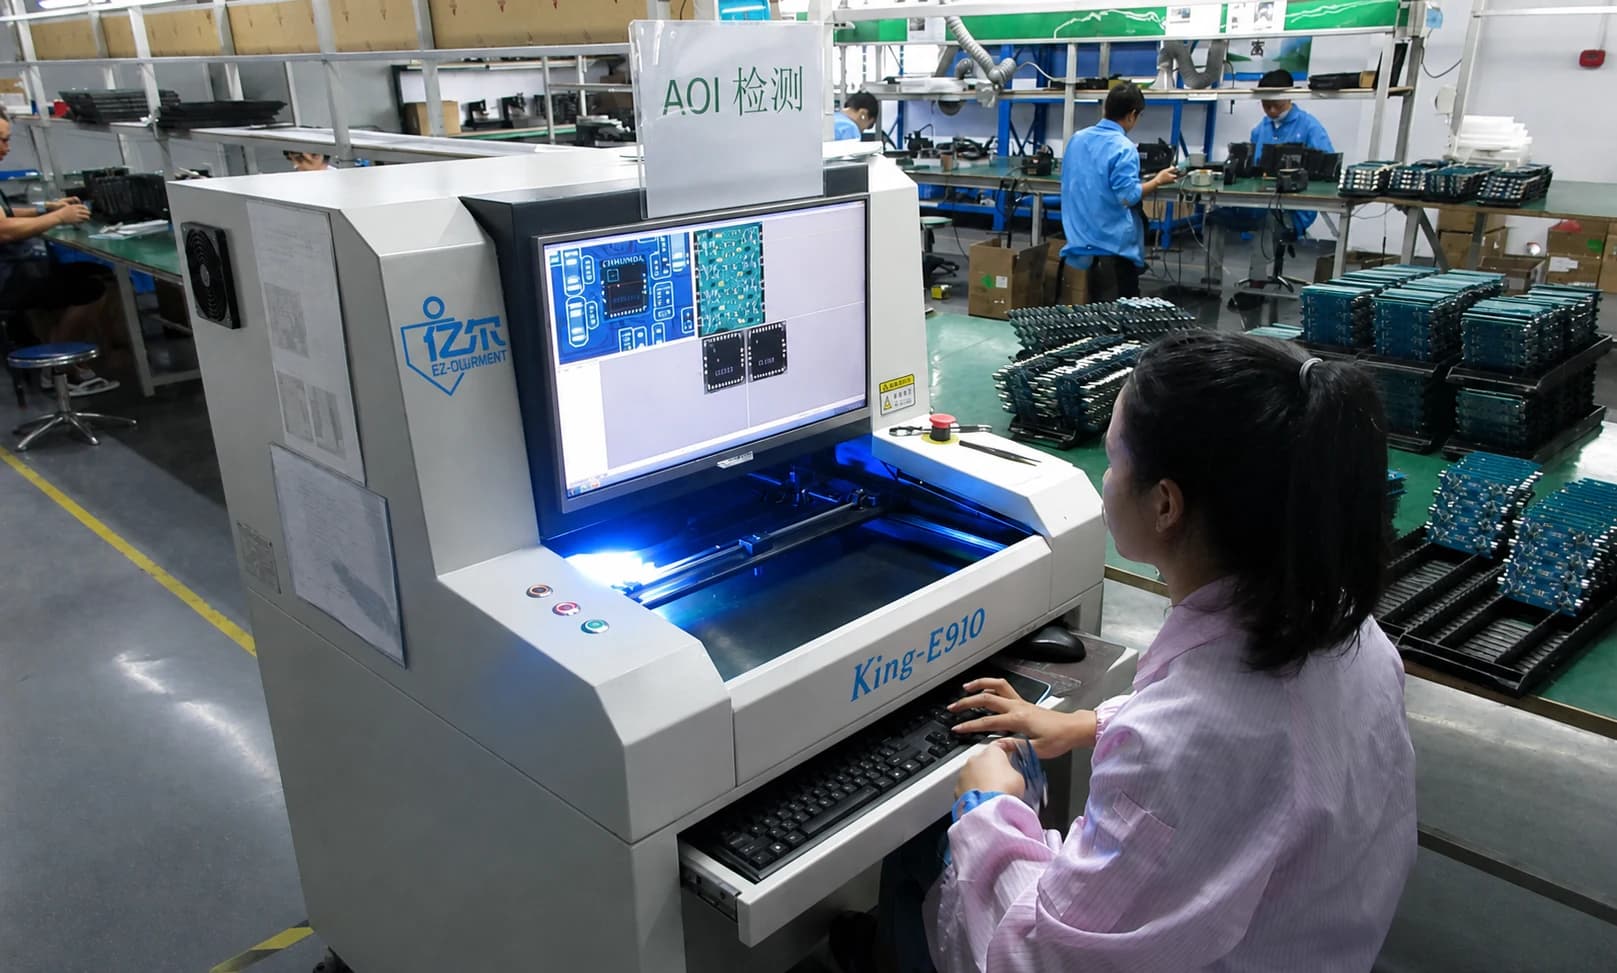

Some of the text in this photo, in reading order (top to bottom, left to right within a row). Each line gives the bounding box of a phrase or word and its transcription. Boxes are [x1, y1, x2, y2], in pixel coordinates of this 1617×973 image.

[663, 66, 803, 116] AOI 检测
[850, 608, 986, 703] King-E910
